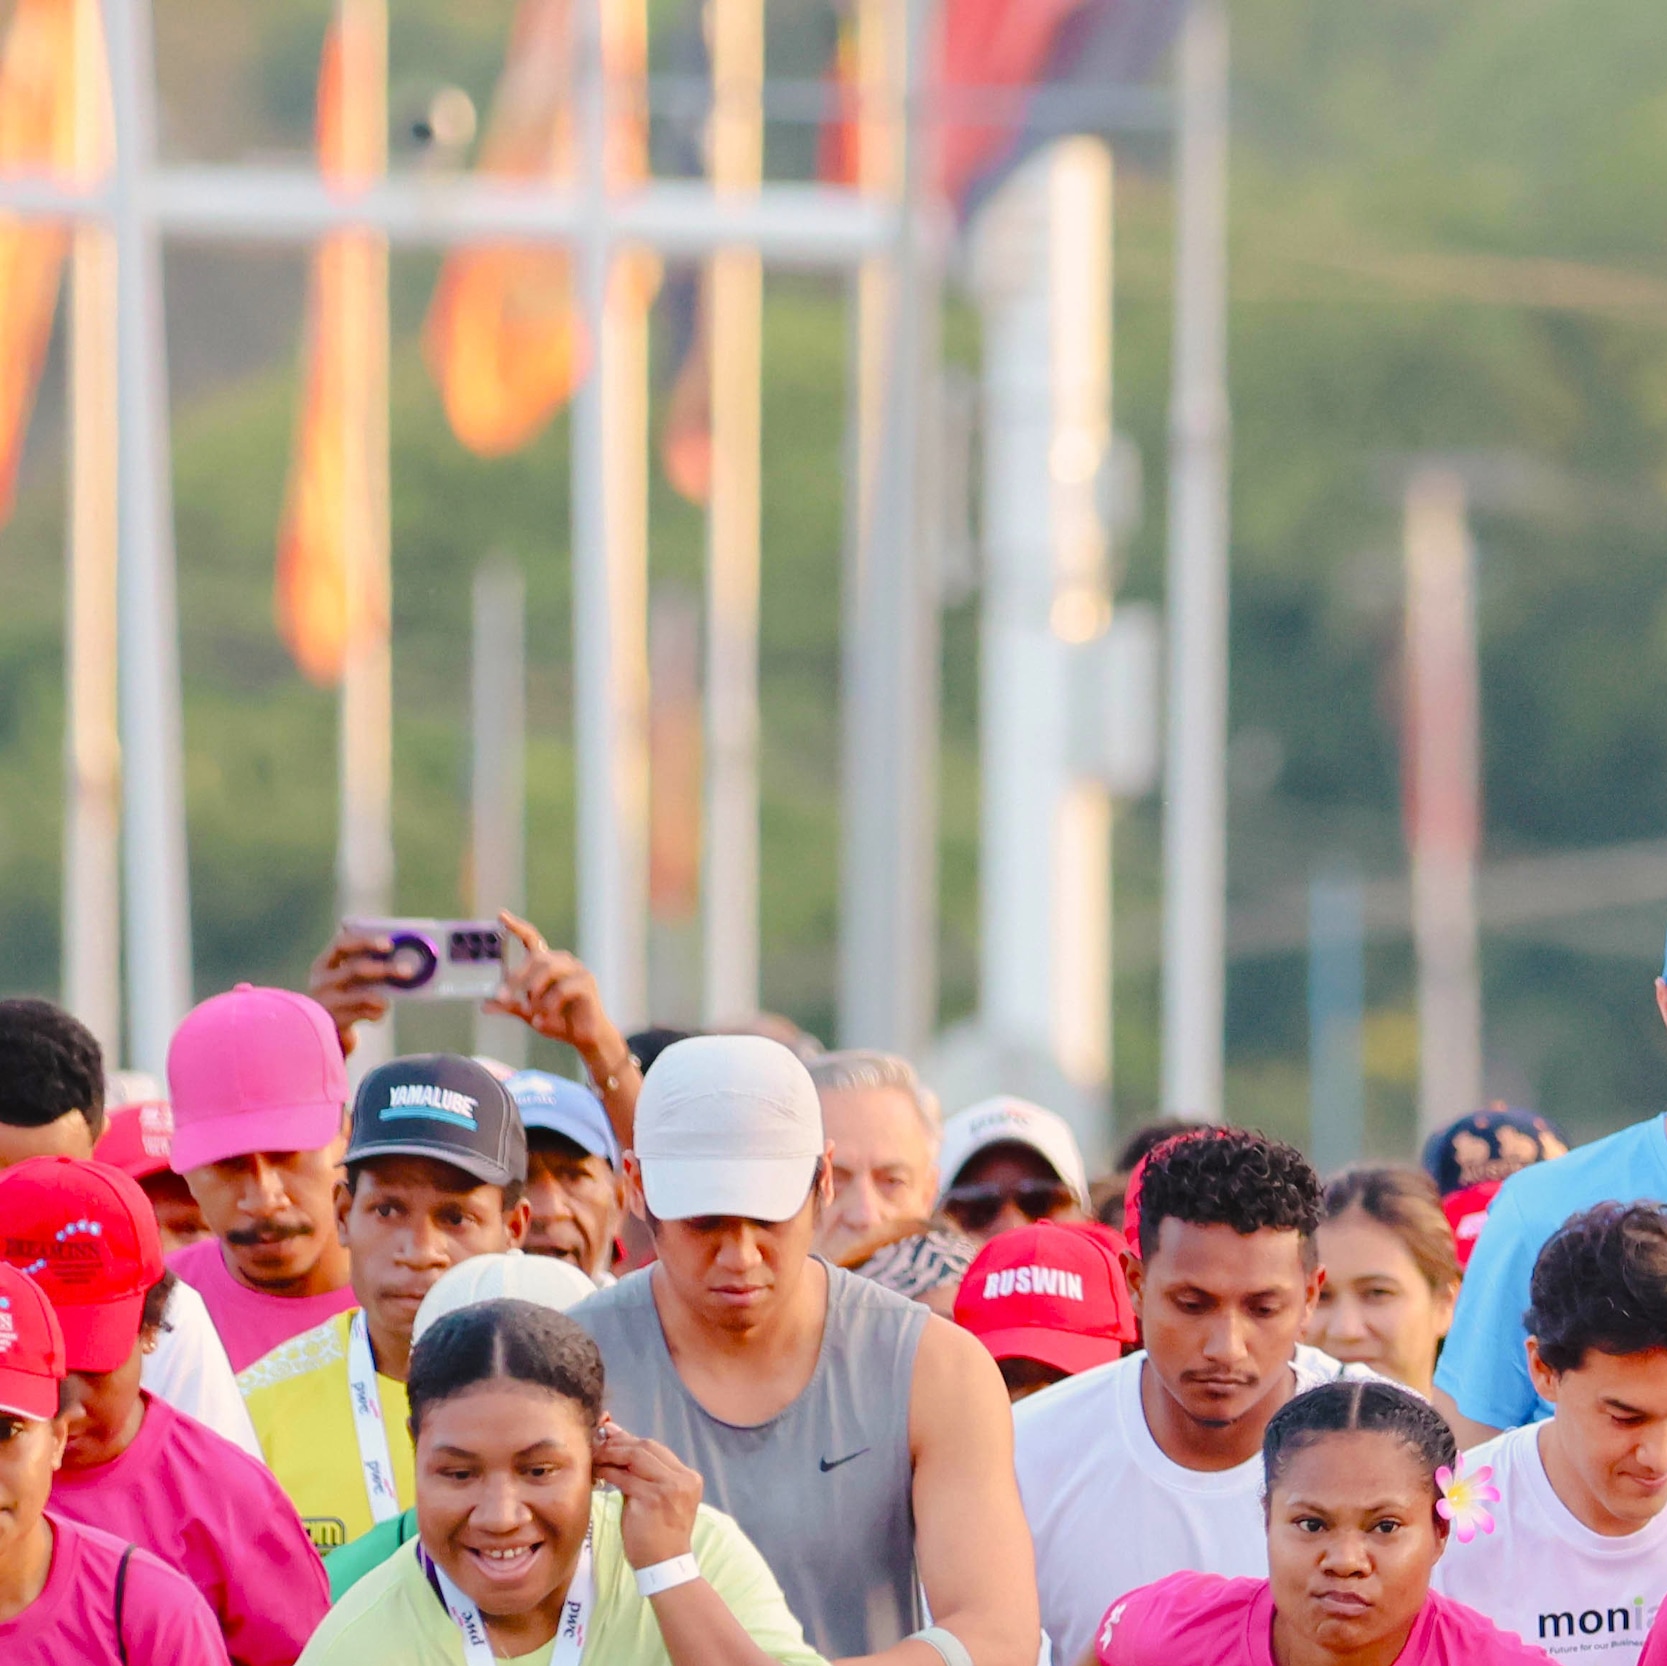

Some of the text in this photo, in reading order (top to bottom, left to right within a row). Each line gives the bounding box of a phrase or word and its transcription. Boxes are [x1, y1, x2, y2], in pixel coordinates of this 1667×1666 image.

[390, 1085, 479, 1119] YAMALUBE
[982, 1264, 1085, 1302] RUSWIN
[351, 1380, 372, 1415] pwc
[364, 1460, 384, 1495] pwc
[461, 1610, 484, 1647] pwc
[562, 1600, 582, 1639] pwc
